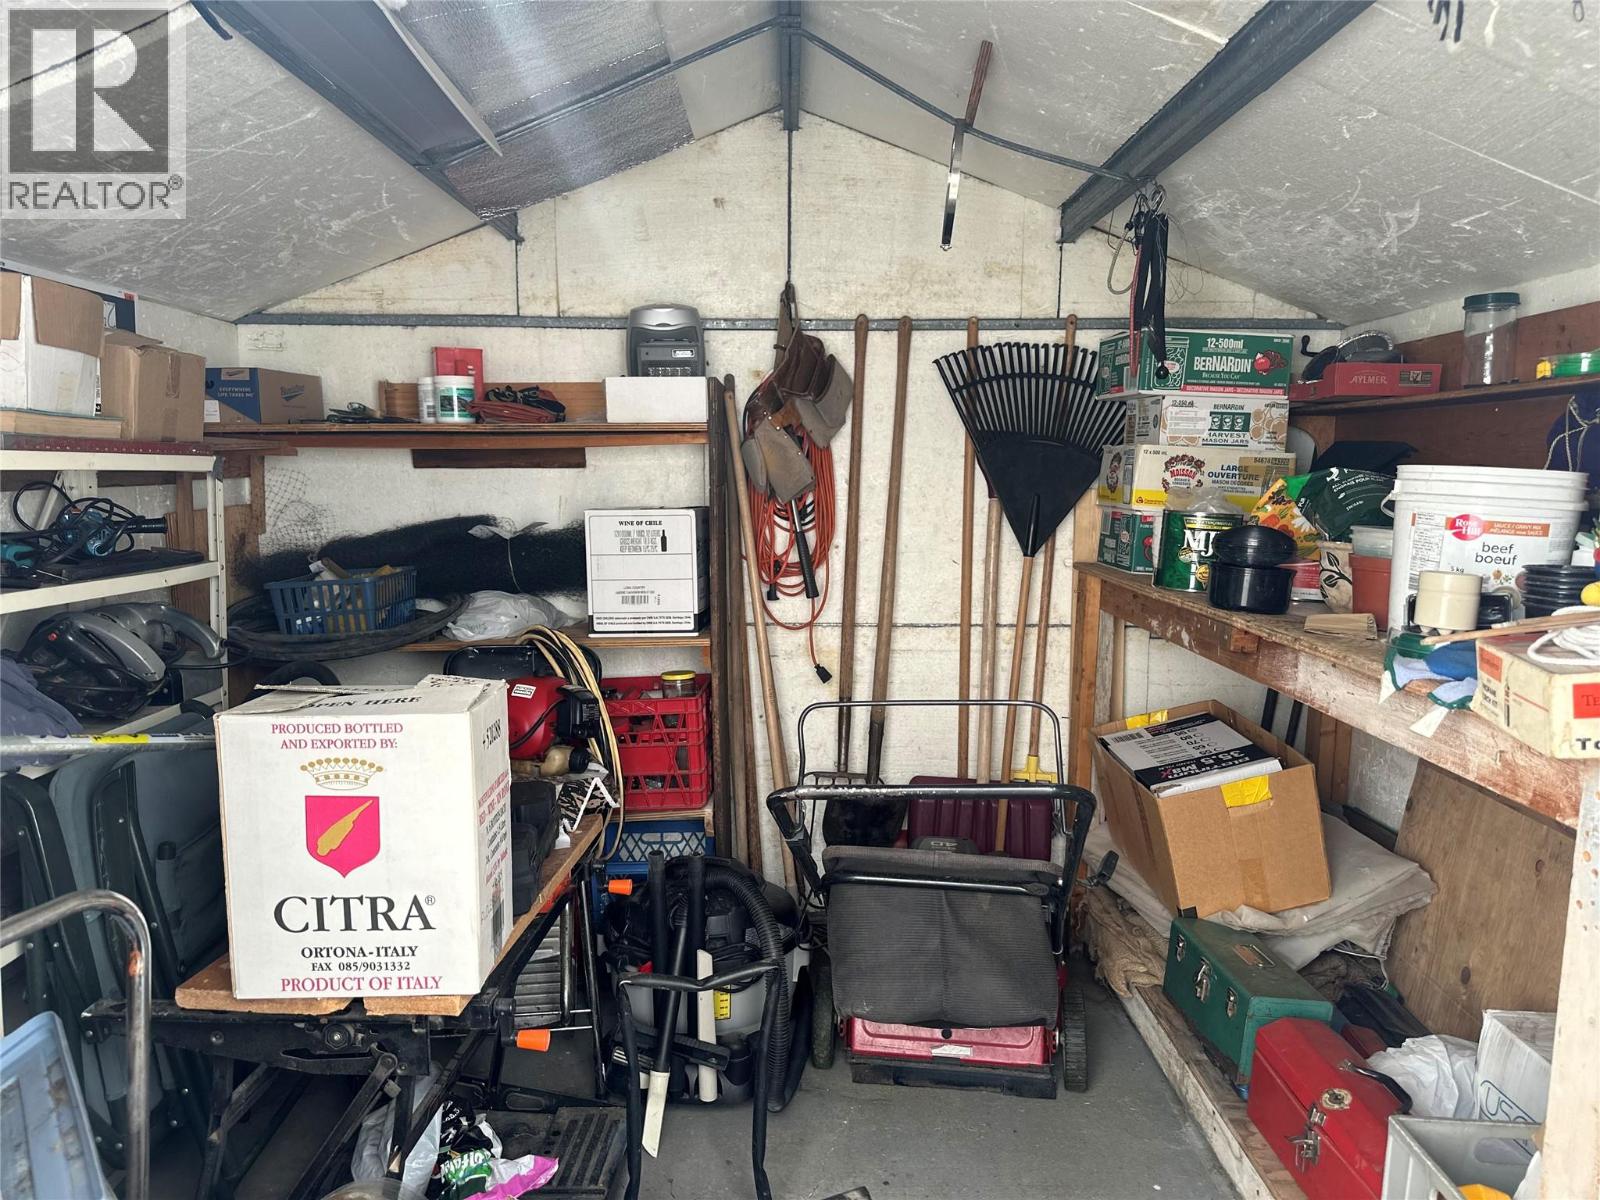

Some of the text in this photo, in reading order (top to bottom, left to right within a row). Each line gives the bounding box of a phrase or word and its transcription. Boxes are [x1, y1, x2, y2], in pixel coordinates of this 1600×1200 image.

[1206, 337, 1244, 350] 12-500ml
[1193, 355, 1252, 373] BERNARDIN
[1350, 376, 1388, 384] AYLMER
[1220, 464, 1249, 473] LARGE
[1207, 471, 1261, 481] OUVERTURE
[1482, 541, 1515, 554] beef
[1474, 553, 1518, 565] boeuf
[364, 696, 422, 705] HERE
[271, 722, 404, 735] PRODUCED BOTTLED
[280, 738, 399, 750] AND EXPORTED BY:
[311, 961, 411, 972] FAX 085/9031332
[281, 975, 443, 992] PRODUCT OF ITALY
